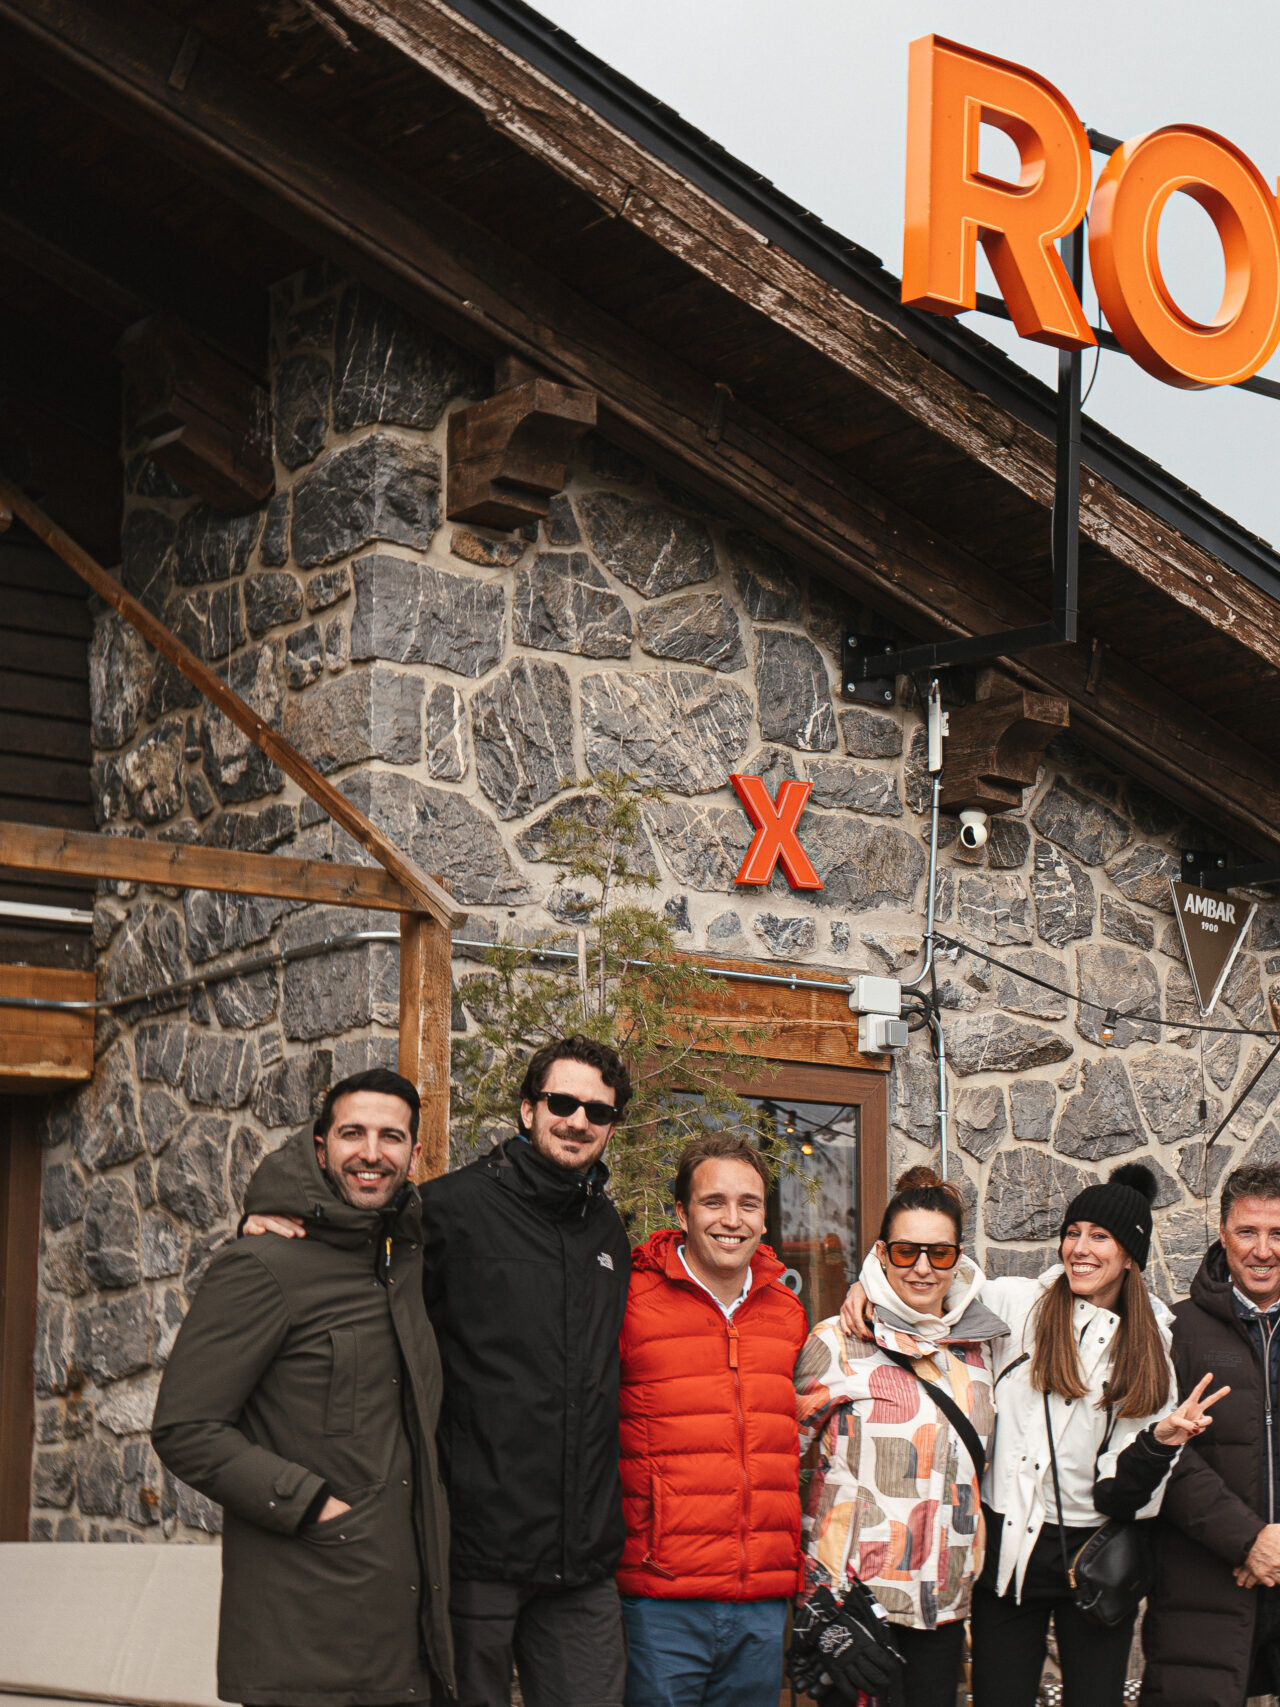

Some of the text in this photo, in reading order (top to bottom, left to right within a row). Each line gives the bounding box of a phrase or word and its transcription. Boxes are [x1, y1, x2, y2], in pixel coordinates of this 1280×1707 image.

[728, 773, 825, 890] X
[1184, 893, 1236, 924] AMBAR
[1201, 921, 1219, 933] 1900
